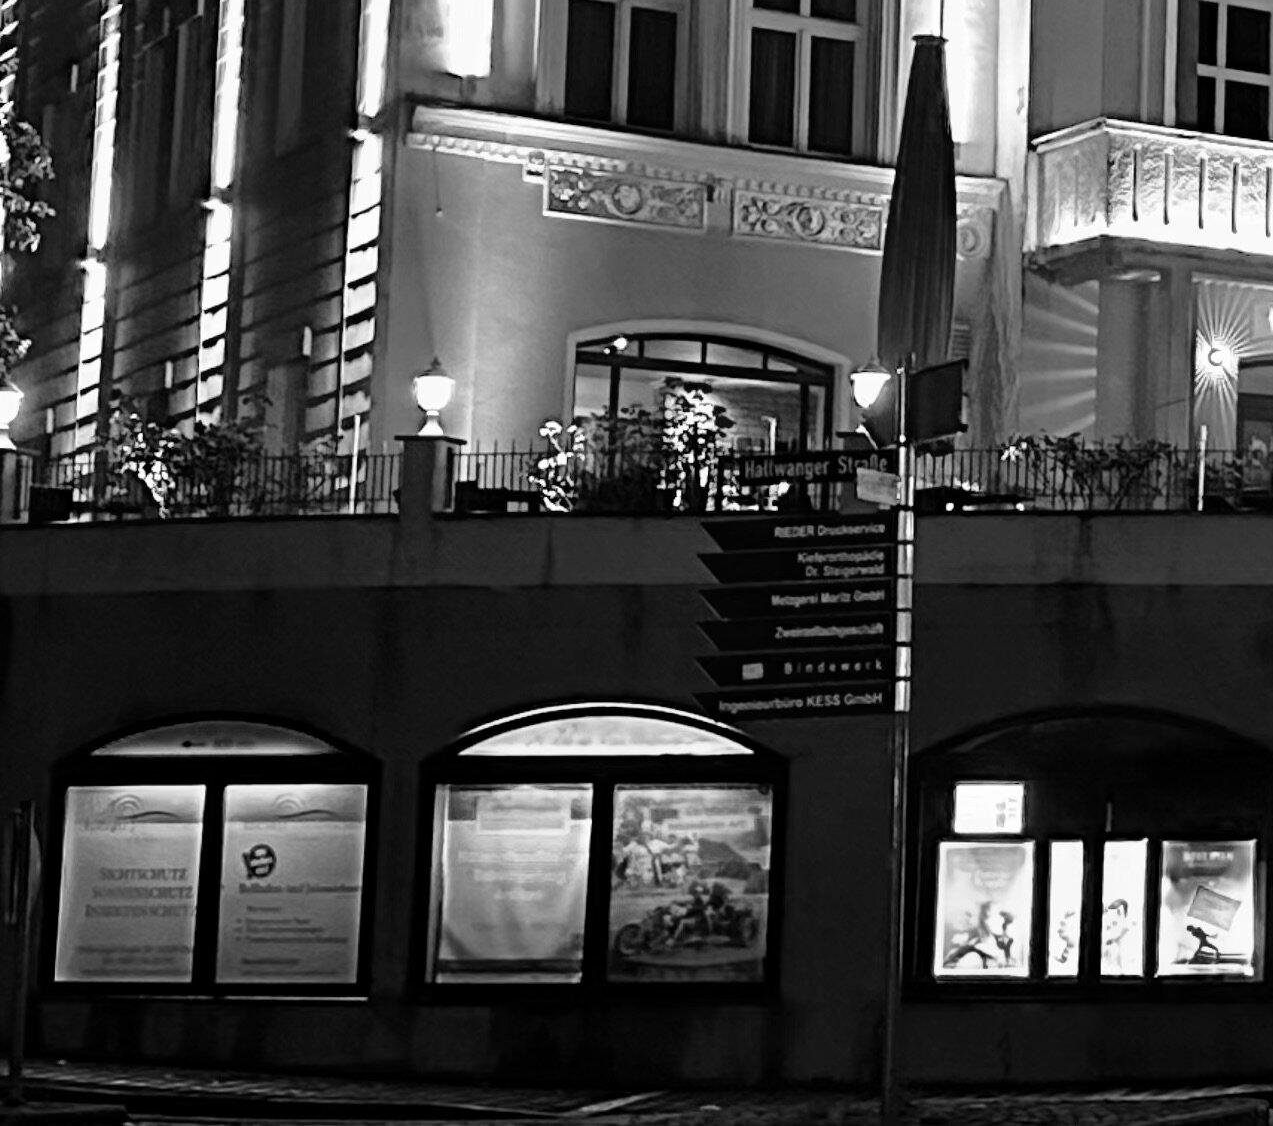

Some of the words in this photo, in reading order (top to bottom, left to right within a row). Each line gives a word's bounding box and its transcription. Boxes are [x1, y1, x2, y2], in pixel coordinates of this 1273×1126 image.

[744, 457, 830, 481] Hallwanger
[837, 453, 888, 474] Straße
[806, 693, 841, 707] KESS
[843, 692, 883, 706] GmbH
